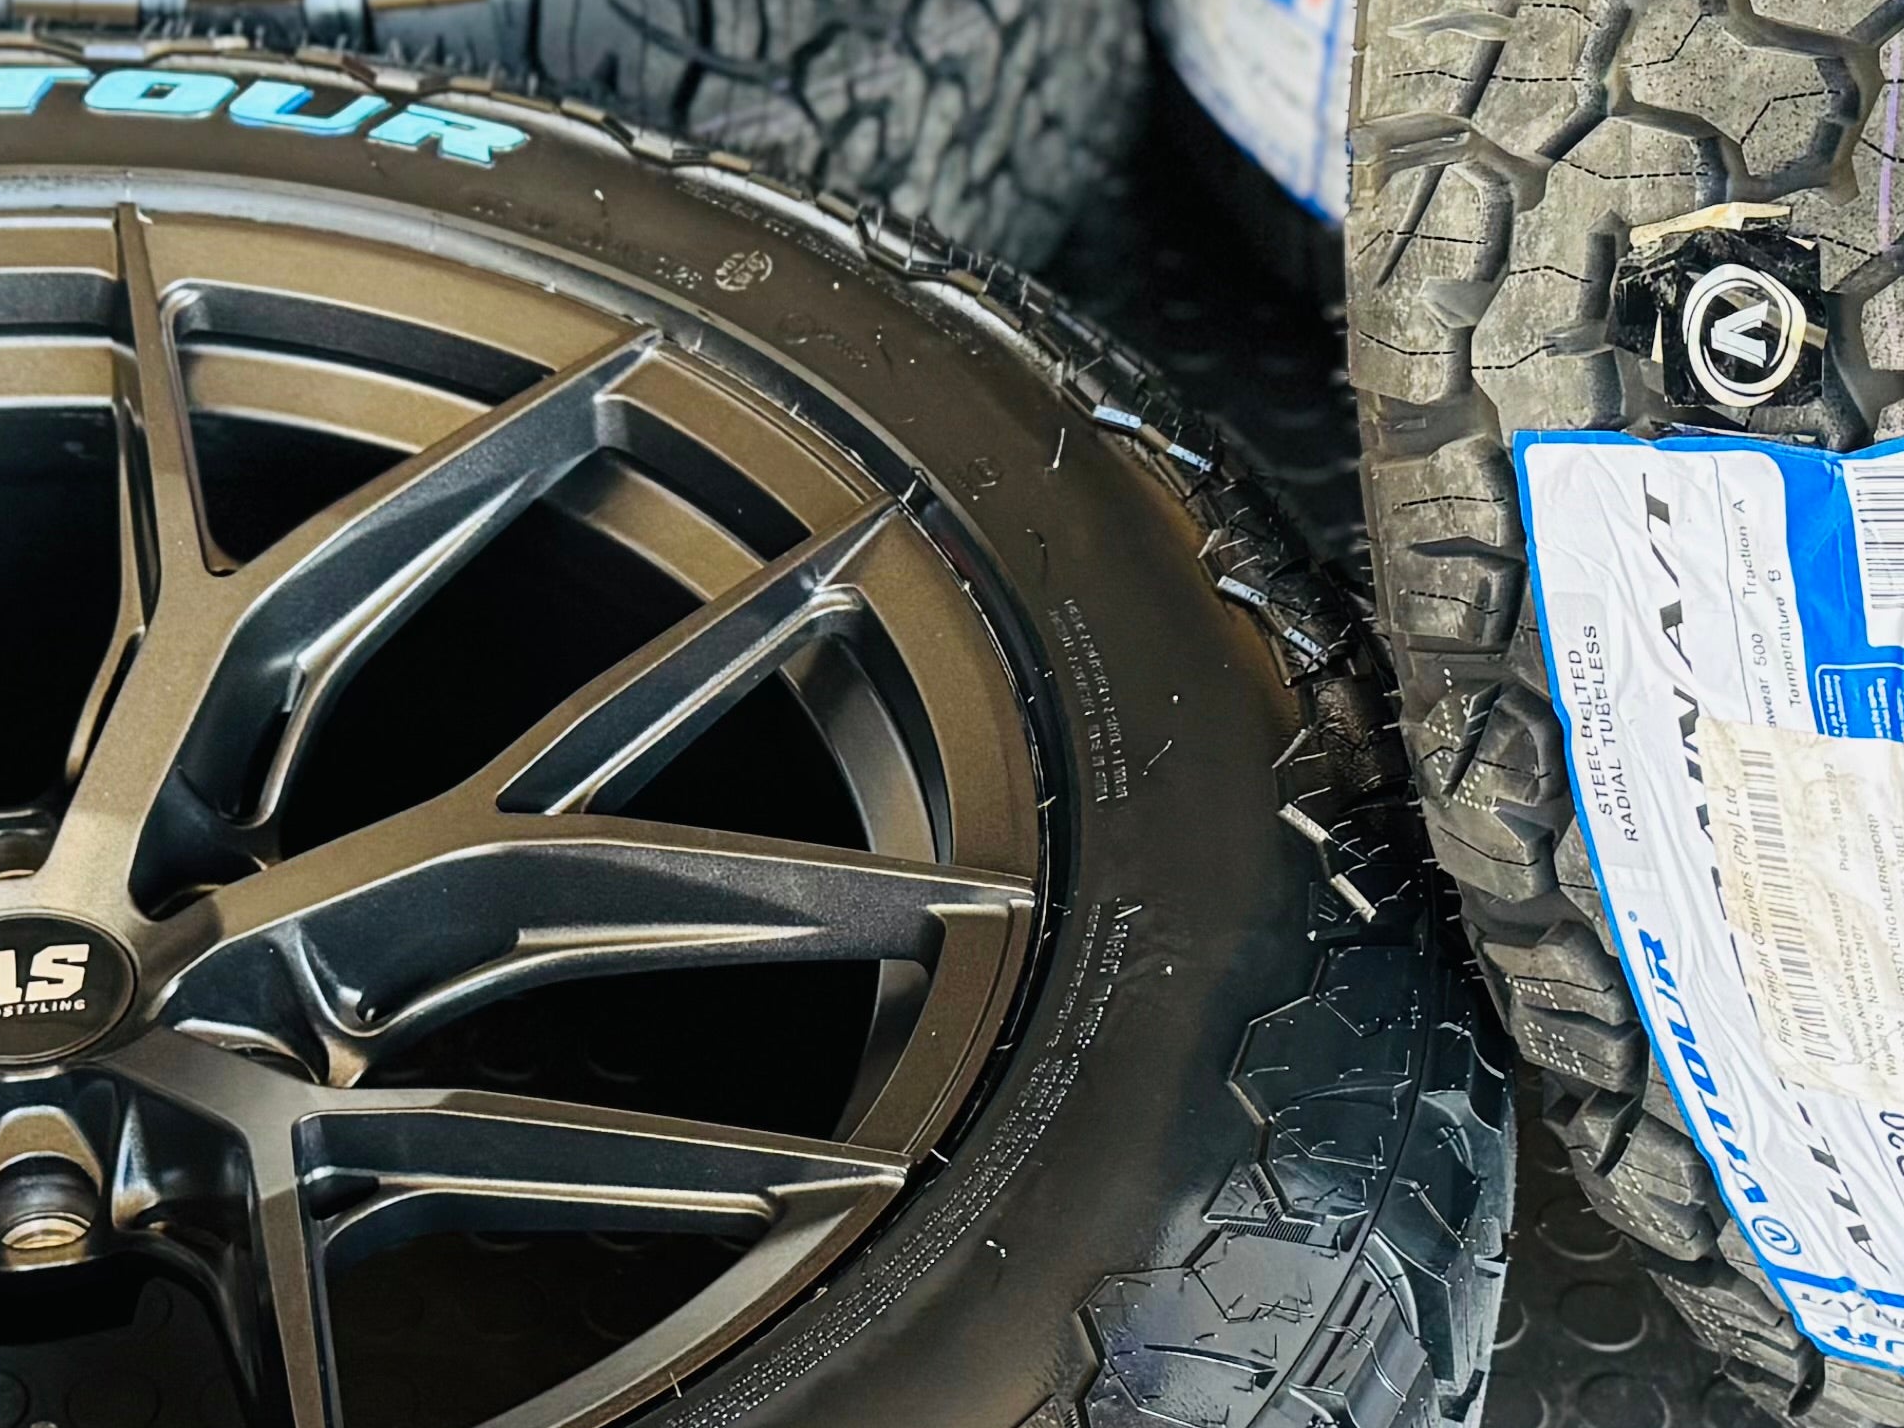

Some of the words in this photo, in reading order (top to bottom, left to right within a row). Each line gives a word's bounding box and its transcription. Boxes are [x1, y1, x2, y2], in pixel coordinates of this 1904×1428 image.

[1643, 473, 1694, 673] A/T
[1735, 524, 1758, 598] Traction
[1581, 623, 1617, 747] TUBELESS
[1750, 632, 1767, 667] 500
[1773, 596, 1802, 707] Temperature
[1566, 648, 1593, 739] BELTED
[1757, 675, 1777, 729] dwear
[1584, 744, 1613, 815] STEEL
[1607, 757, 1639, 842] RADIAL
[1722, 783, 1741, 818] Ltd
[1635, 928, 1769, 1208] VITOUR
